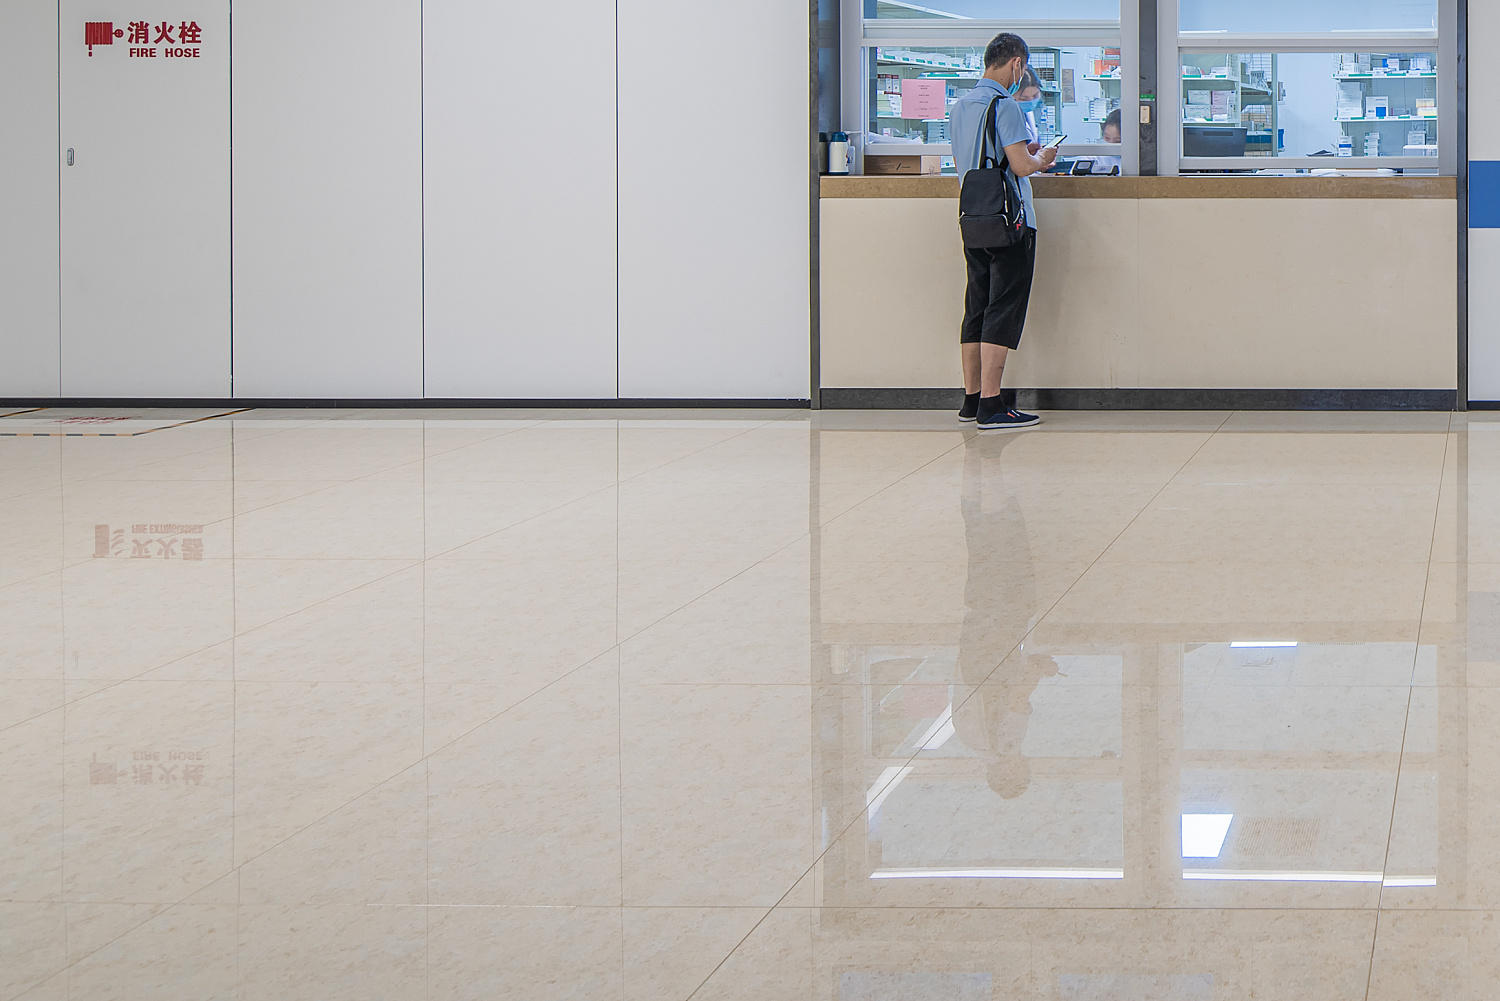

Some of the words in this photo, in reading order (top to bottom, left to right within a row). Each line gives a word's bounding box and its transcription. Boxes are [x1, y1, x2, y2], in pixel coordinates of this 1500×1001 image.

[127, 20, 202, 44] 消火栓
[129, 47, 157, 58] FIRE
[164, 47, 201, 58] HOSE
